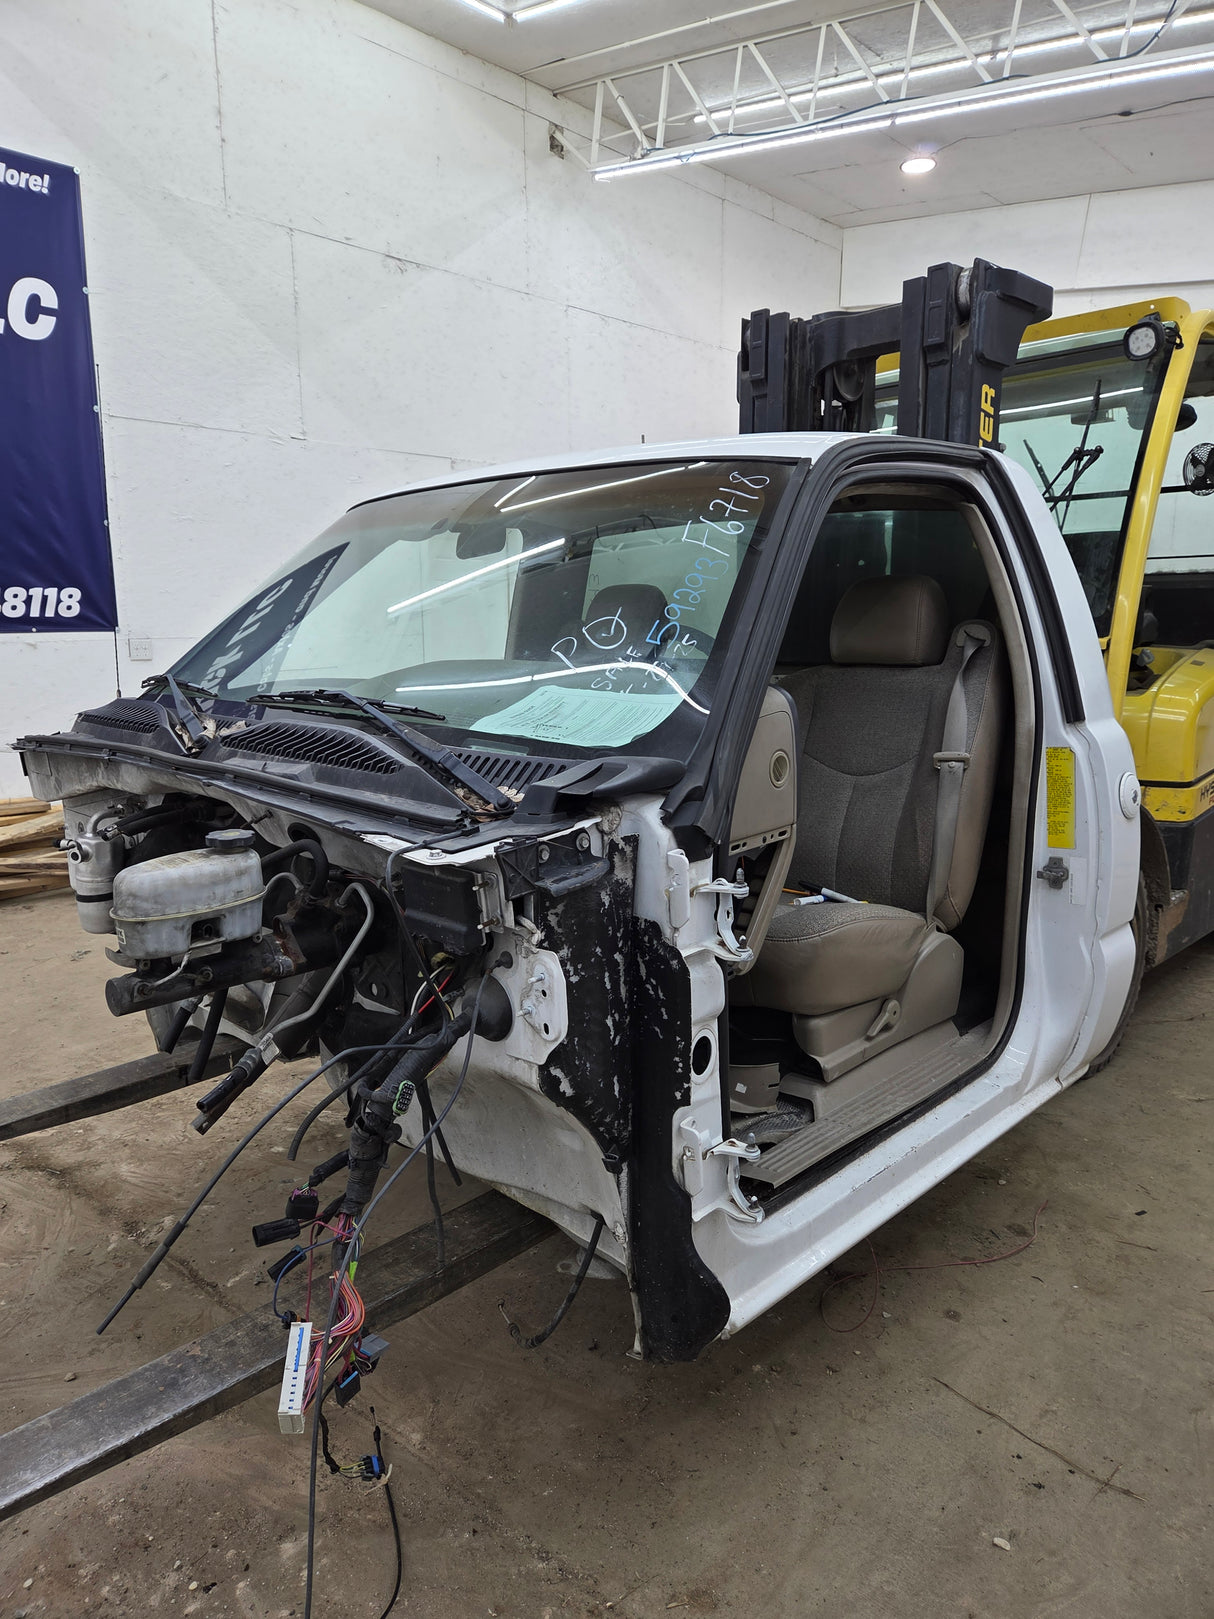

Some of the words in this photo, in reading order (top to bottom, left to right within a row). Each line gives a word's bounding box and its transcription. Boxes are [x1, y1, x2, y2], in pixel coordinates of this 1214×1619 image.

[0, 277, 58, 341] C
[682, 471, 770, 557] F6718
[0, 586, 82, 618] 8118
